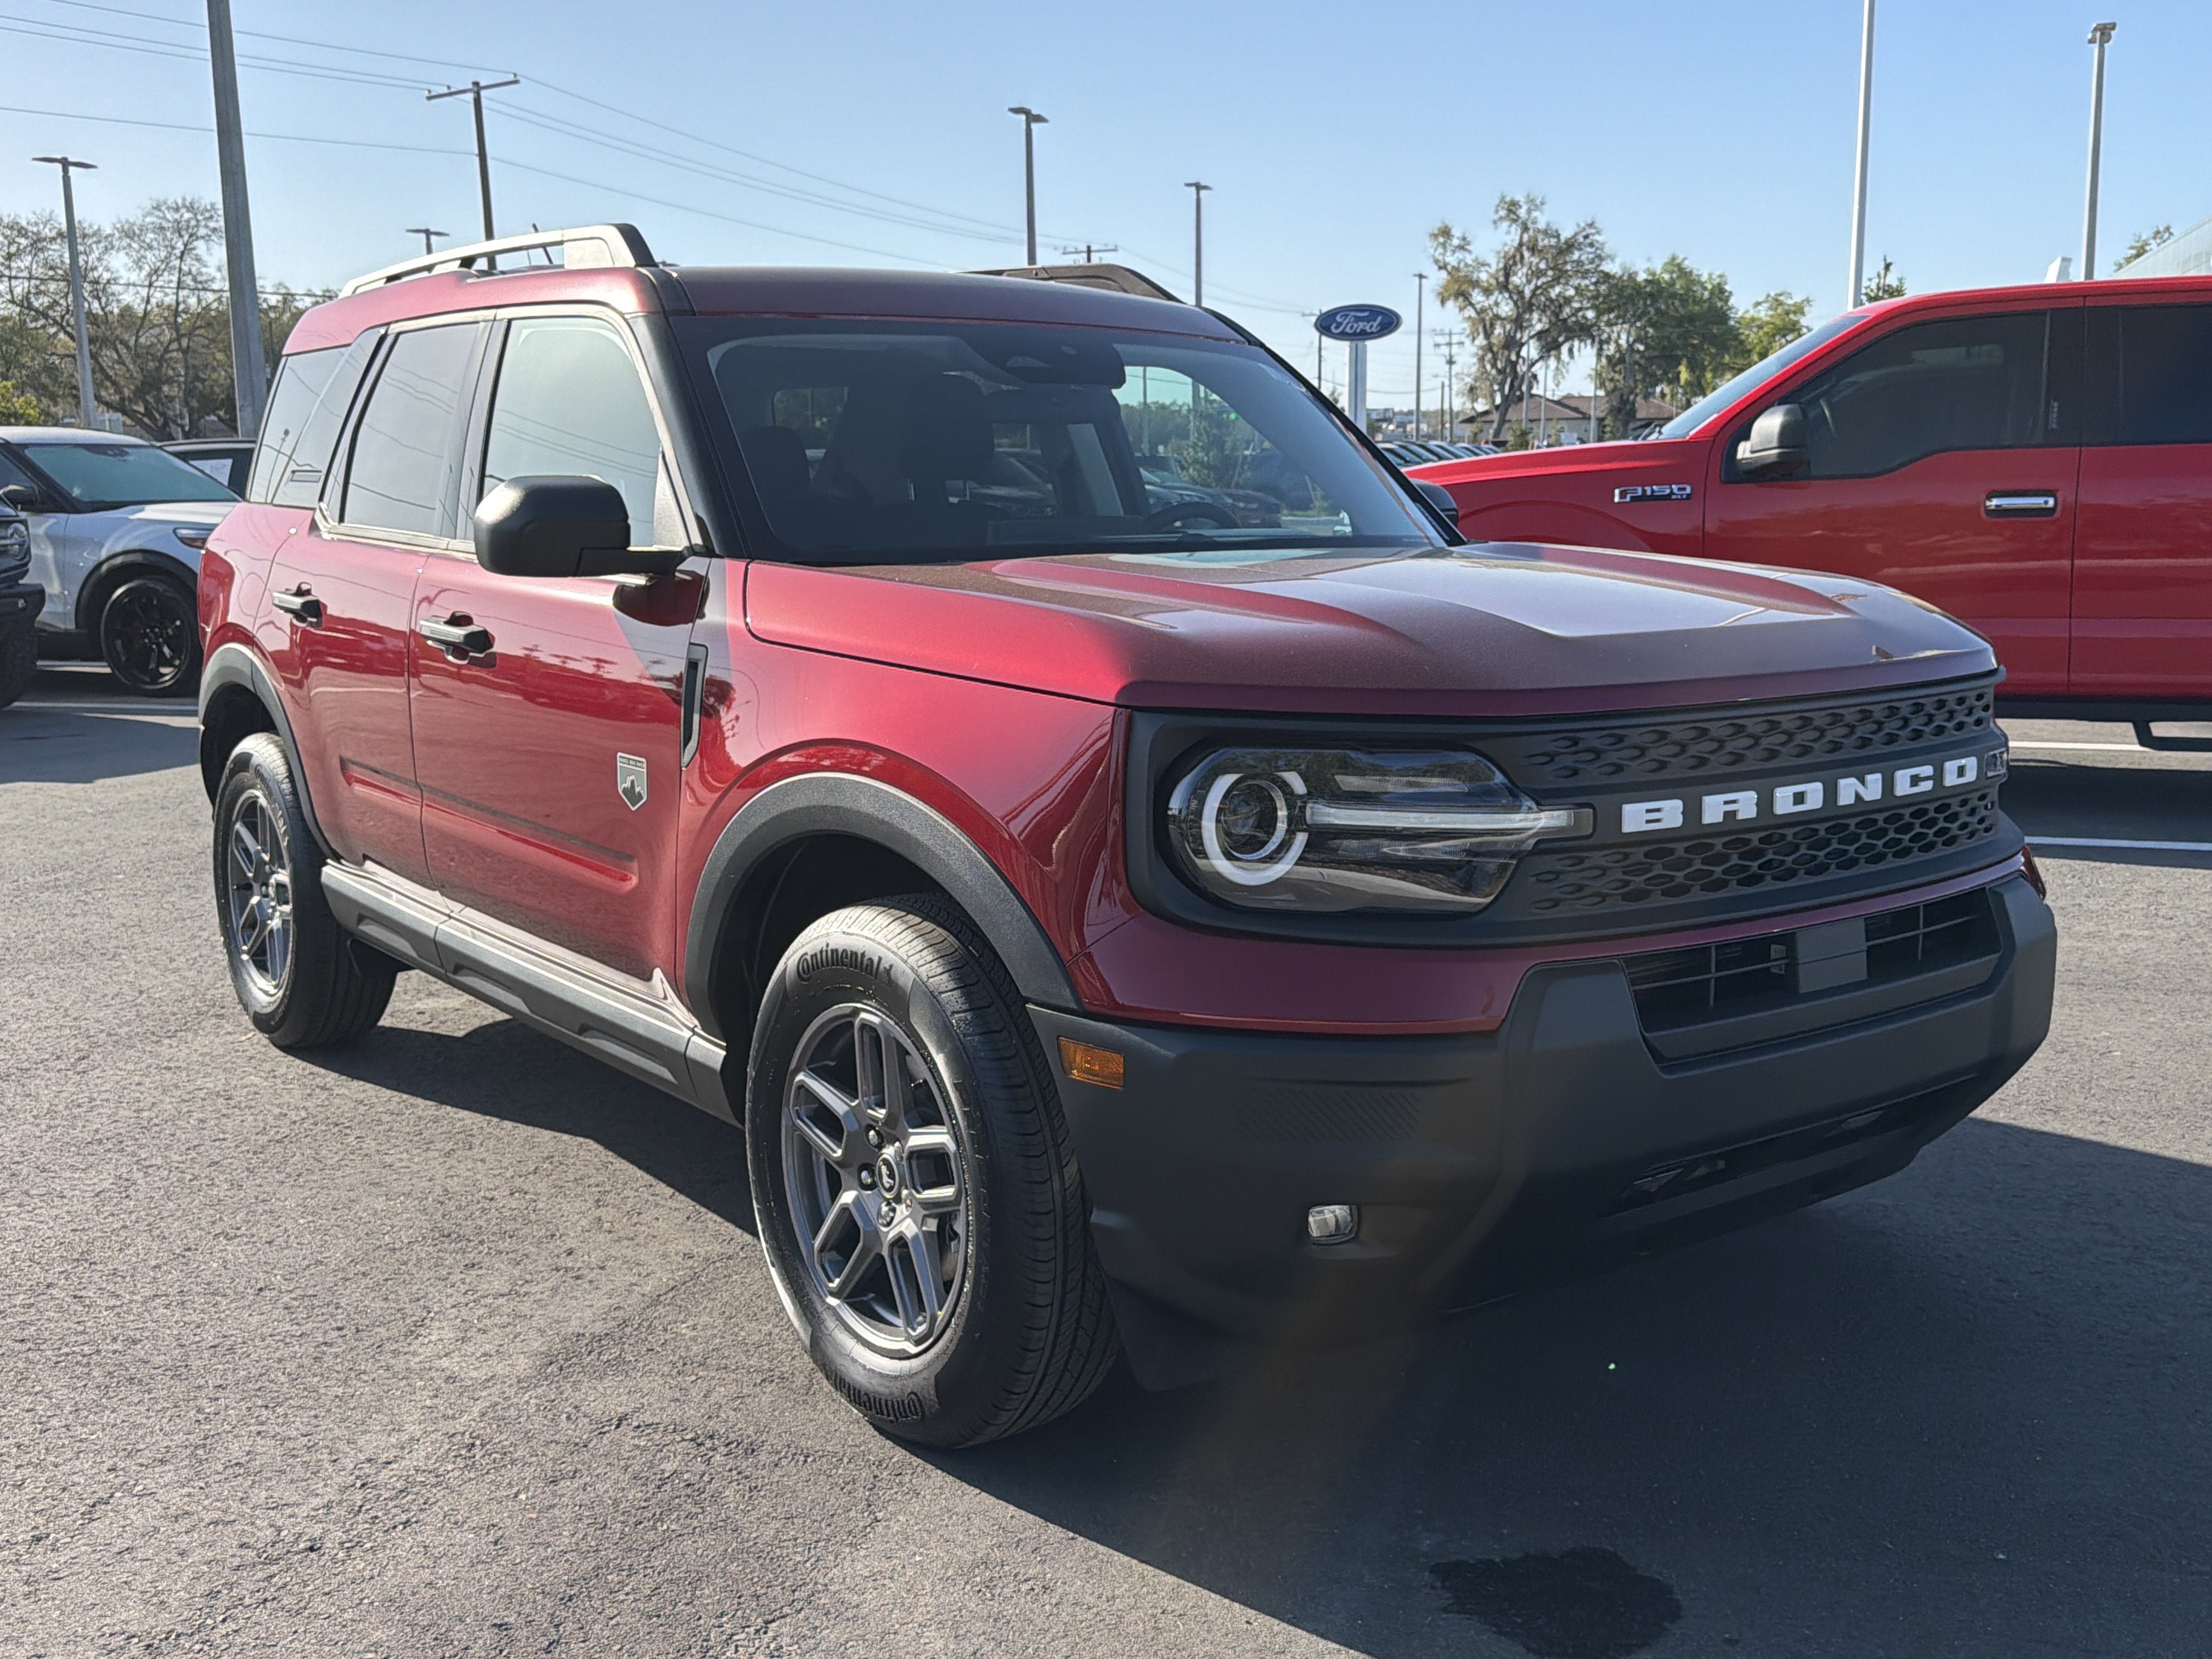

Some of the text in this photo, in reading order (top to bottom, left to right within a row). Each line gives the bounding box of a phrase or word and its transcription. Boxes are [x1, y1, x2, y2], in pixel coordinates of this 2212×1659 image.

[1330, 311, 1382, 334] Ford
[1621, 756, 1977, 833] BRONCO
[797, 941, 883, 983] Continental
